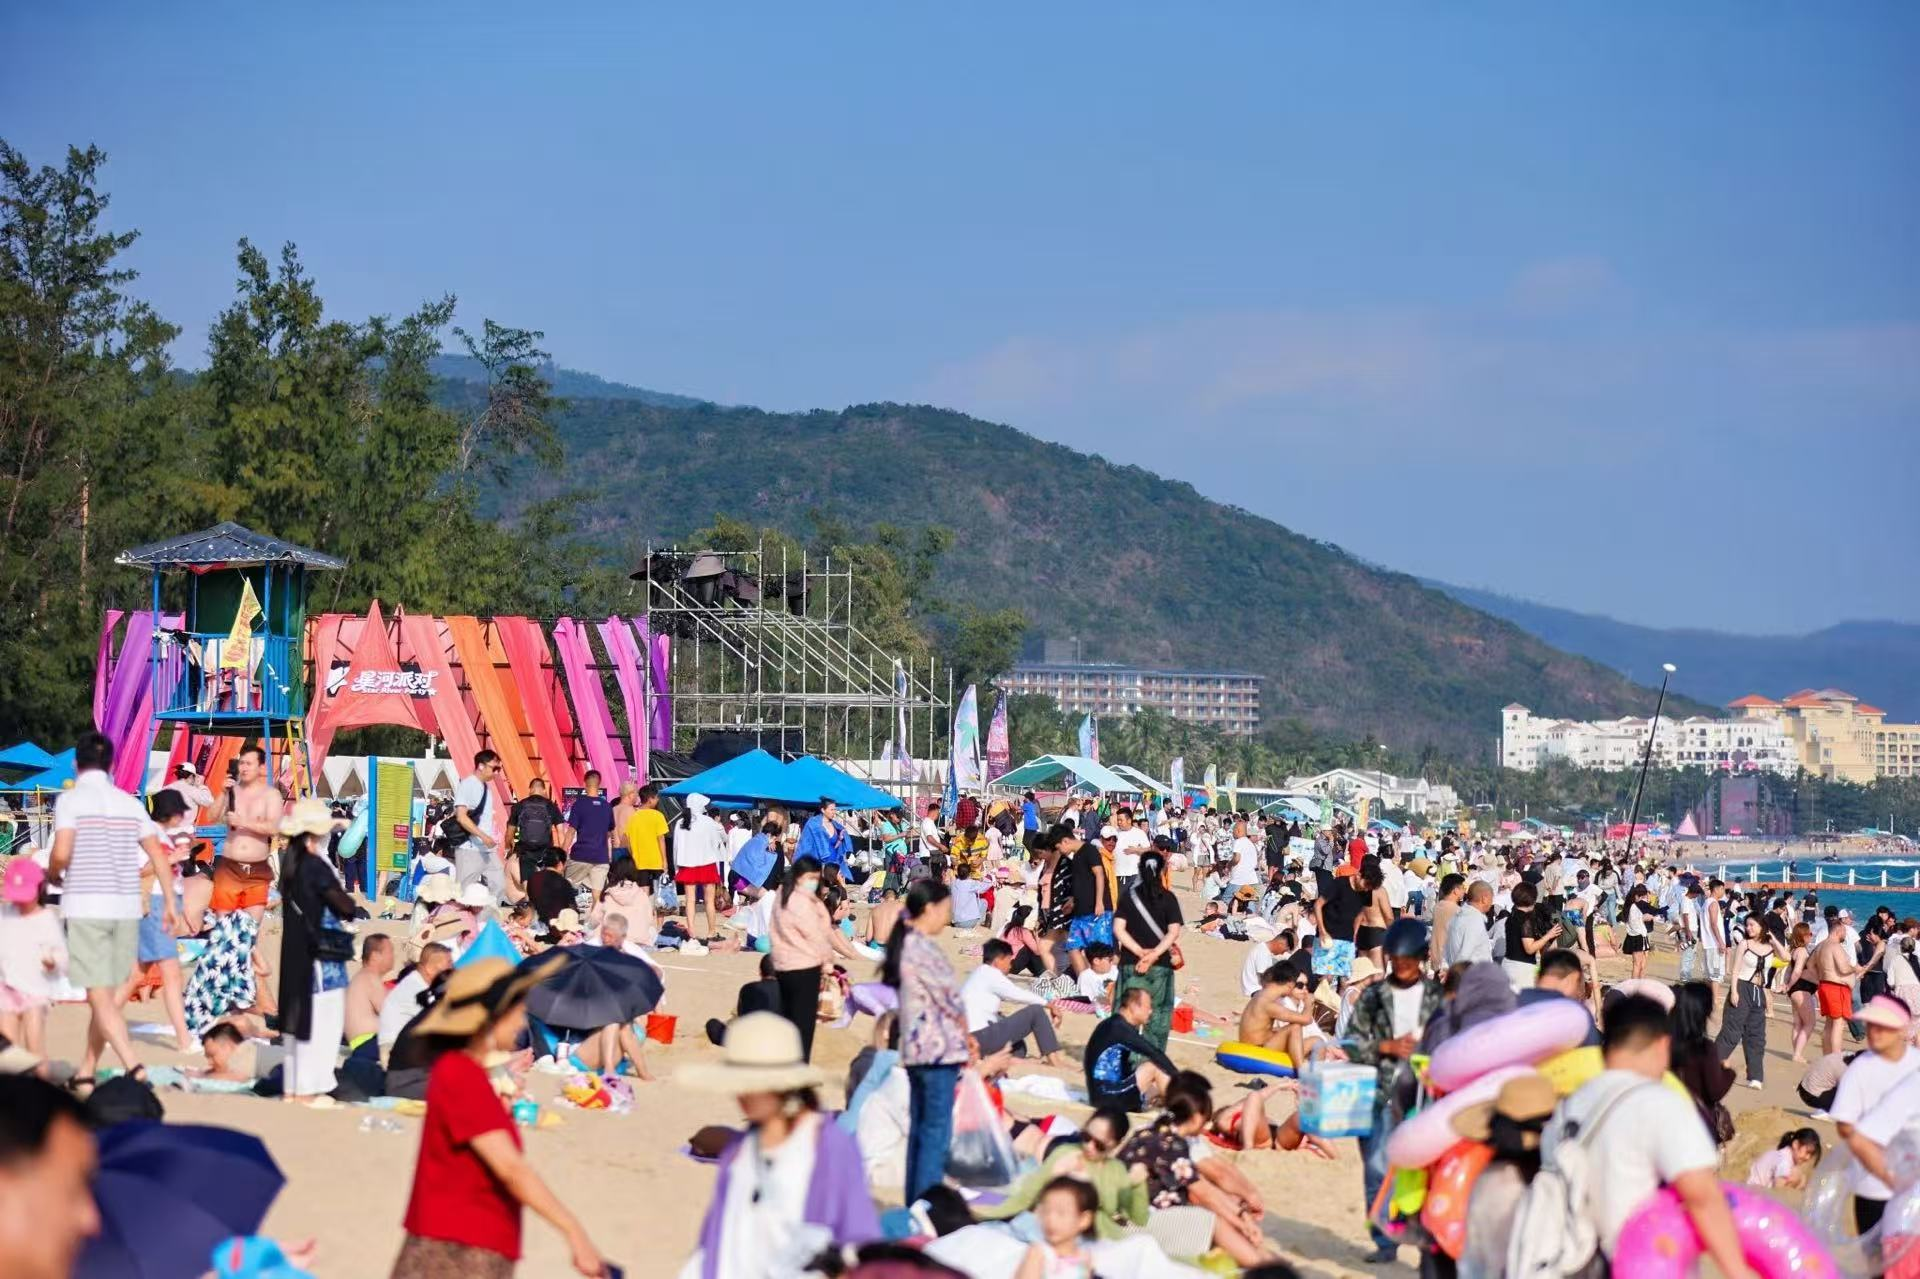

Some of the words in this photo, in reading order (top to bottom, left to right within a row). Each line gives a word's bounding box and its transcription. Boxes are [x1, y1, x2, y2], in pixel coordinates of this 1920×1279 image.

[351, 671, 438, 692] 星河派对
[404, 688, 426, 696] Party
